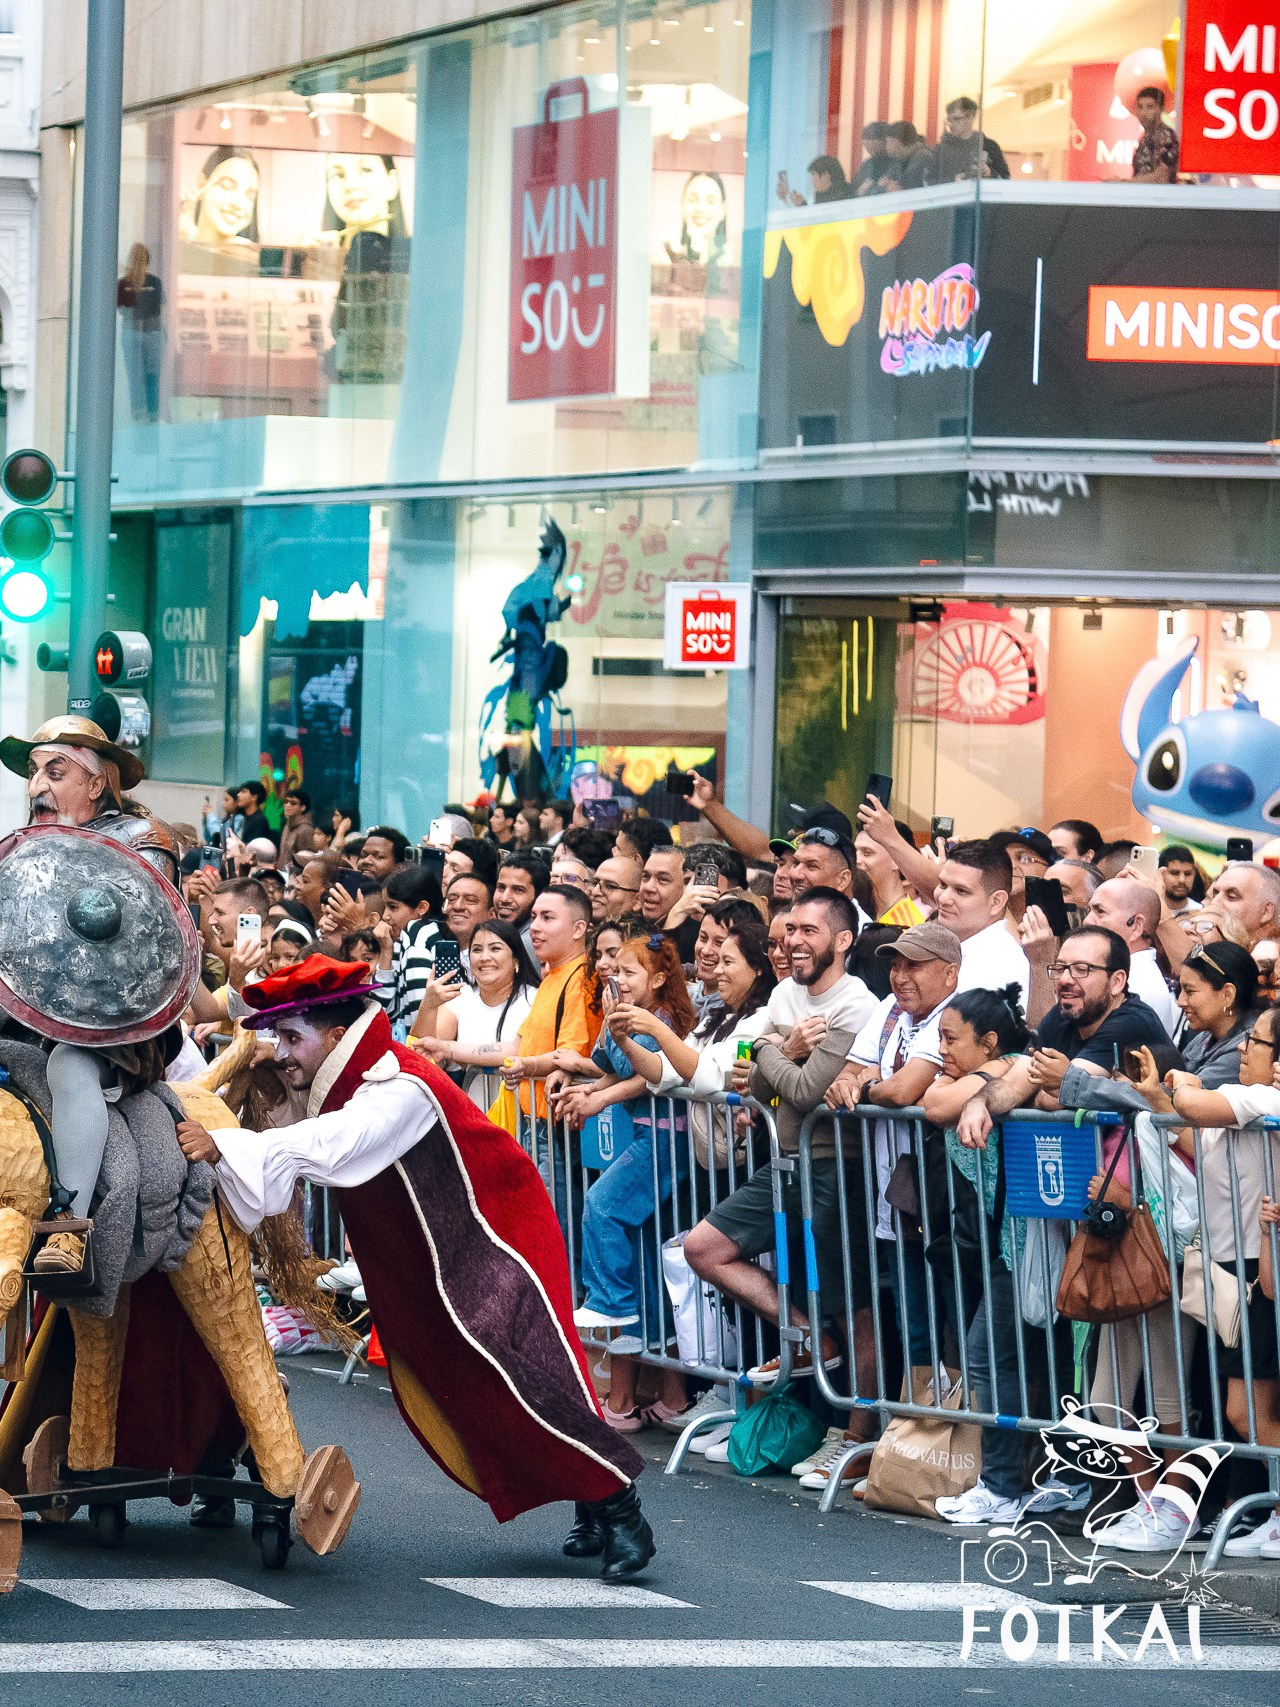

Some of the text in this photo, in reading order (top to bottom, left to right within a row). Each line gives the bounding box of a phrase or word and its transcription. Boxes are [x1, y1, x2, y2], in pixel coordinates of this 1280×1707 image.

[1204, 22, 1280, 74] MI
[521, 177, 607, 259] MINI
[879, 277, 976, 341] NARUTO
[162, 607, 207, 641] GRAN
[685, 611, 732, 631] MINI
[173, 647, 217, 682] VIEW
